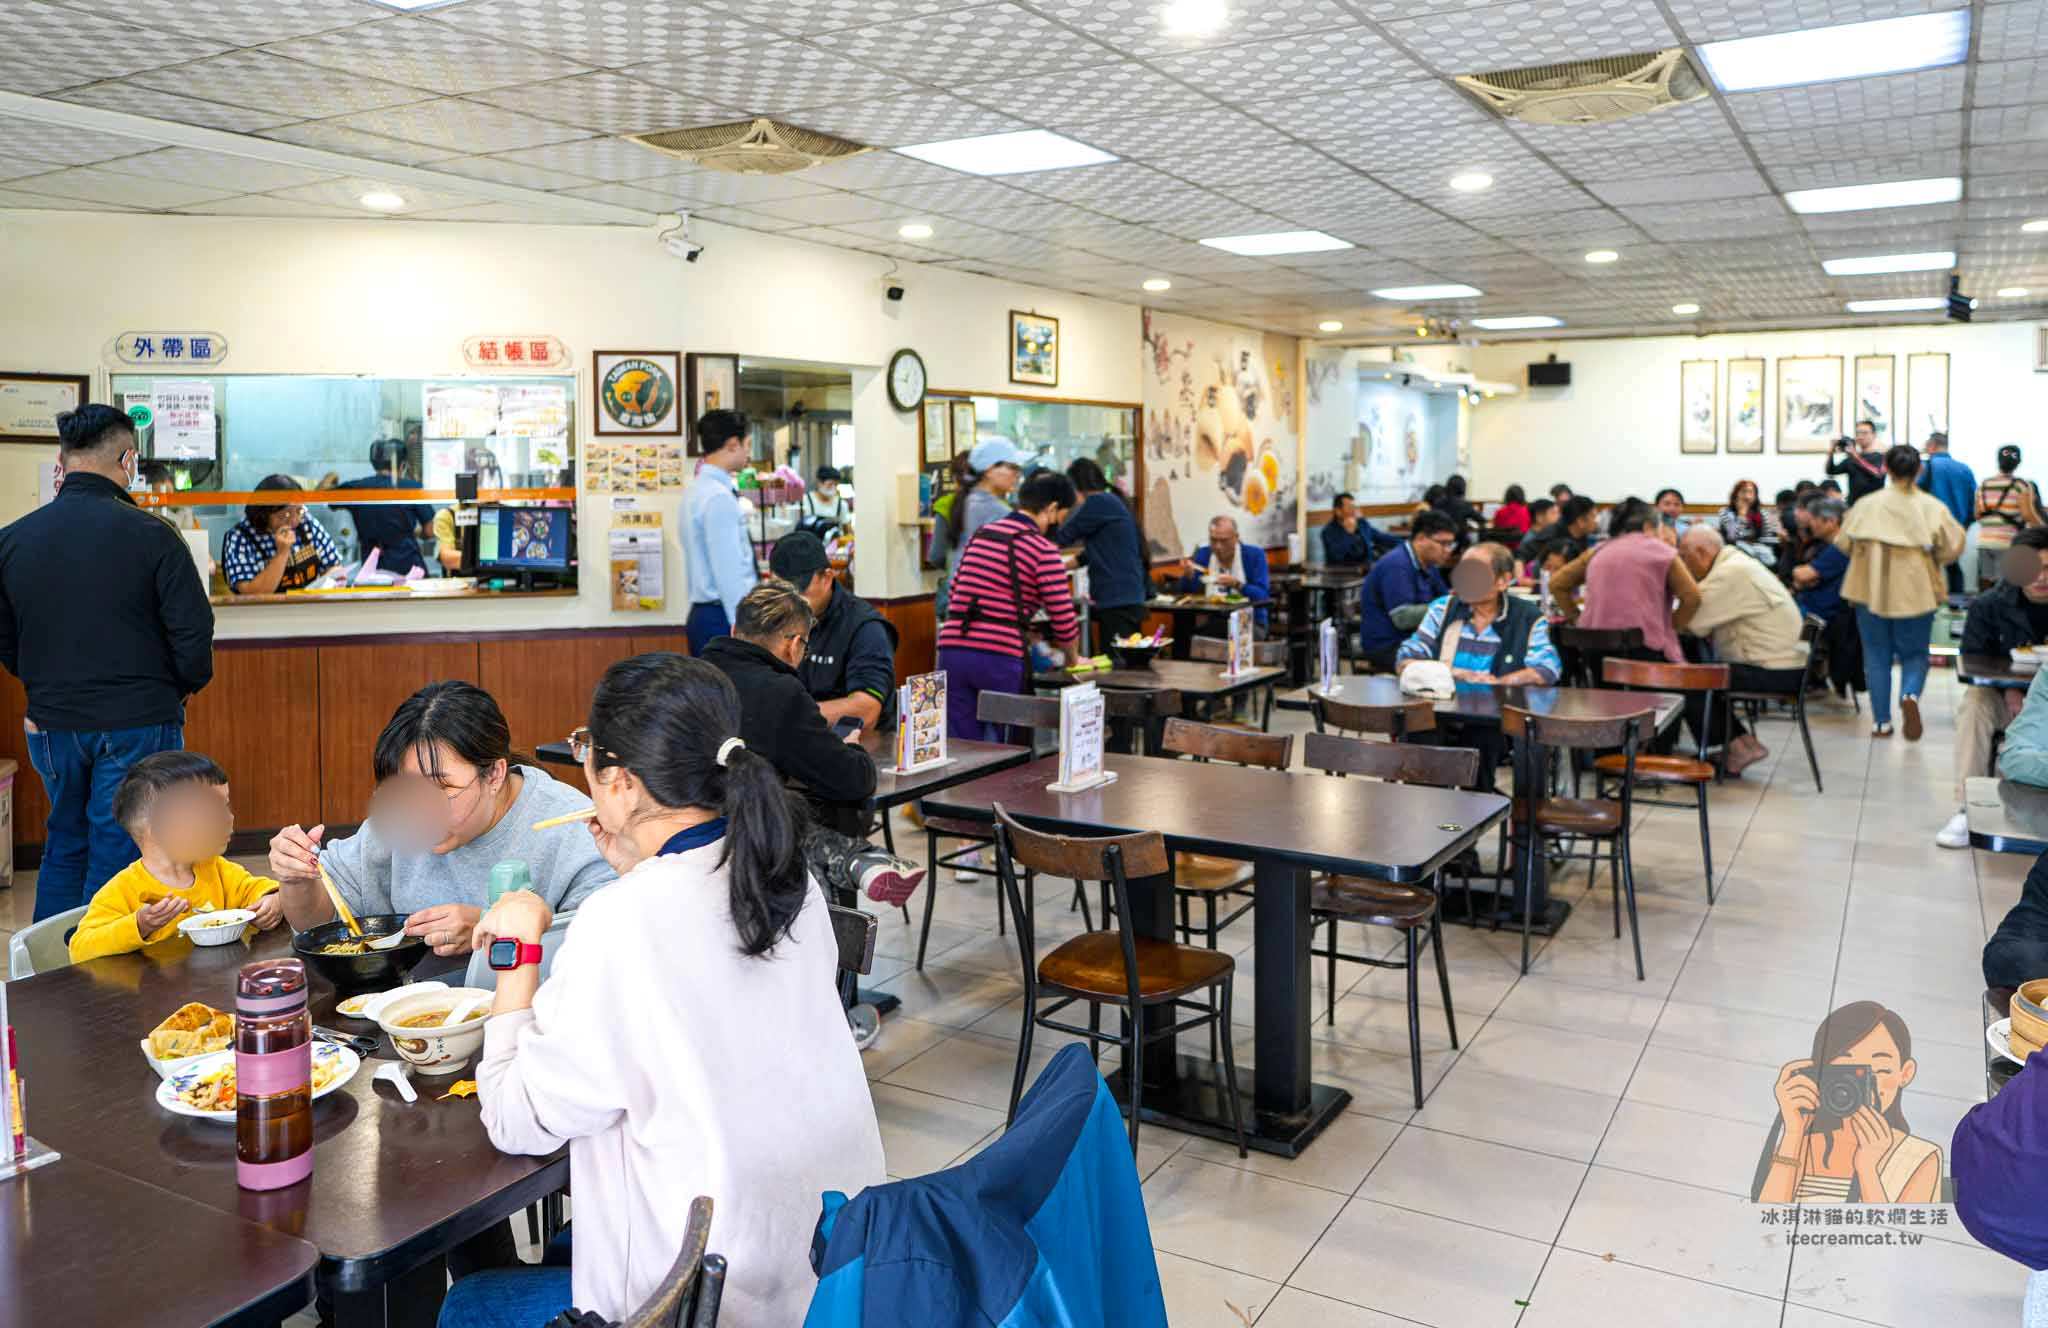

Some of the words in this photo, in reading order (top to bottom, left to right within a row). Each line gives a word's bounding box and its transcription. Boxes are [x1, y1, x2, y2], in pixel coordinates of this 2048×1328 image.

[134, 337, 210, 359] 外帶區
[479, 341, 548, 360] 結帳區
